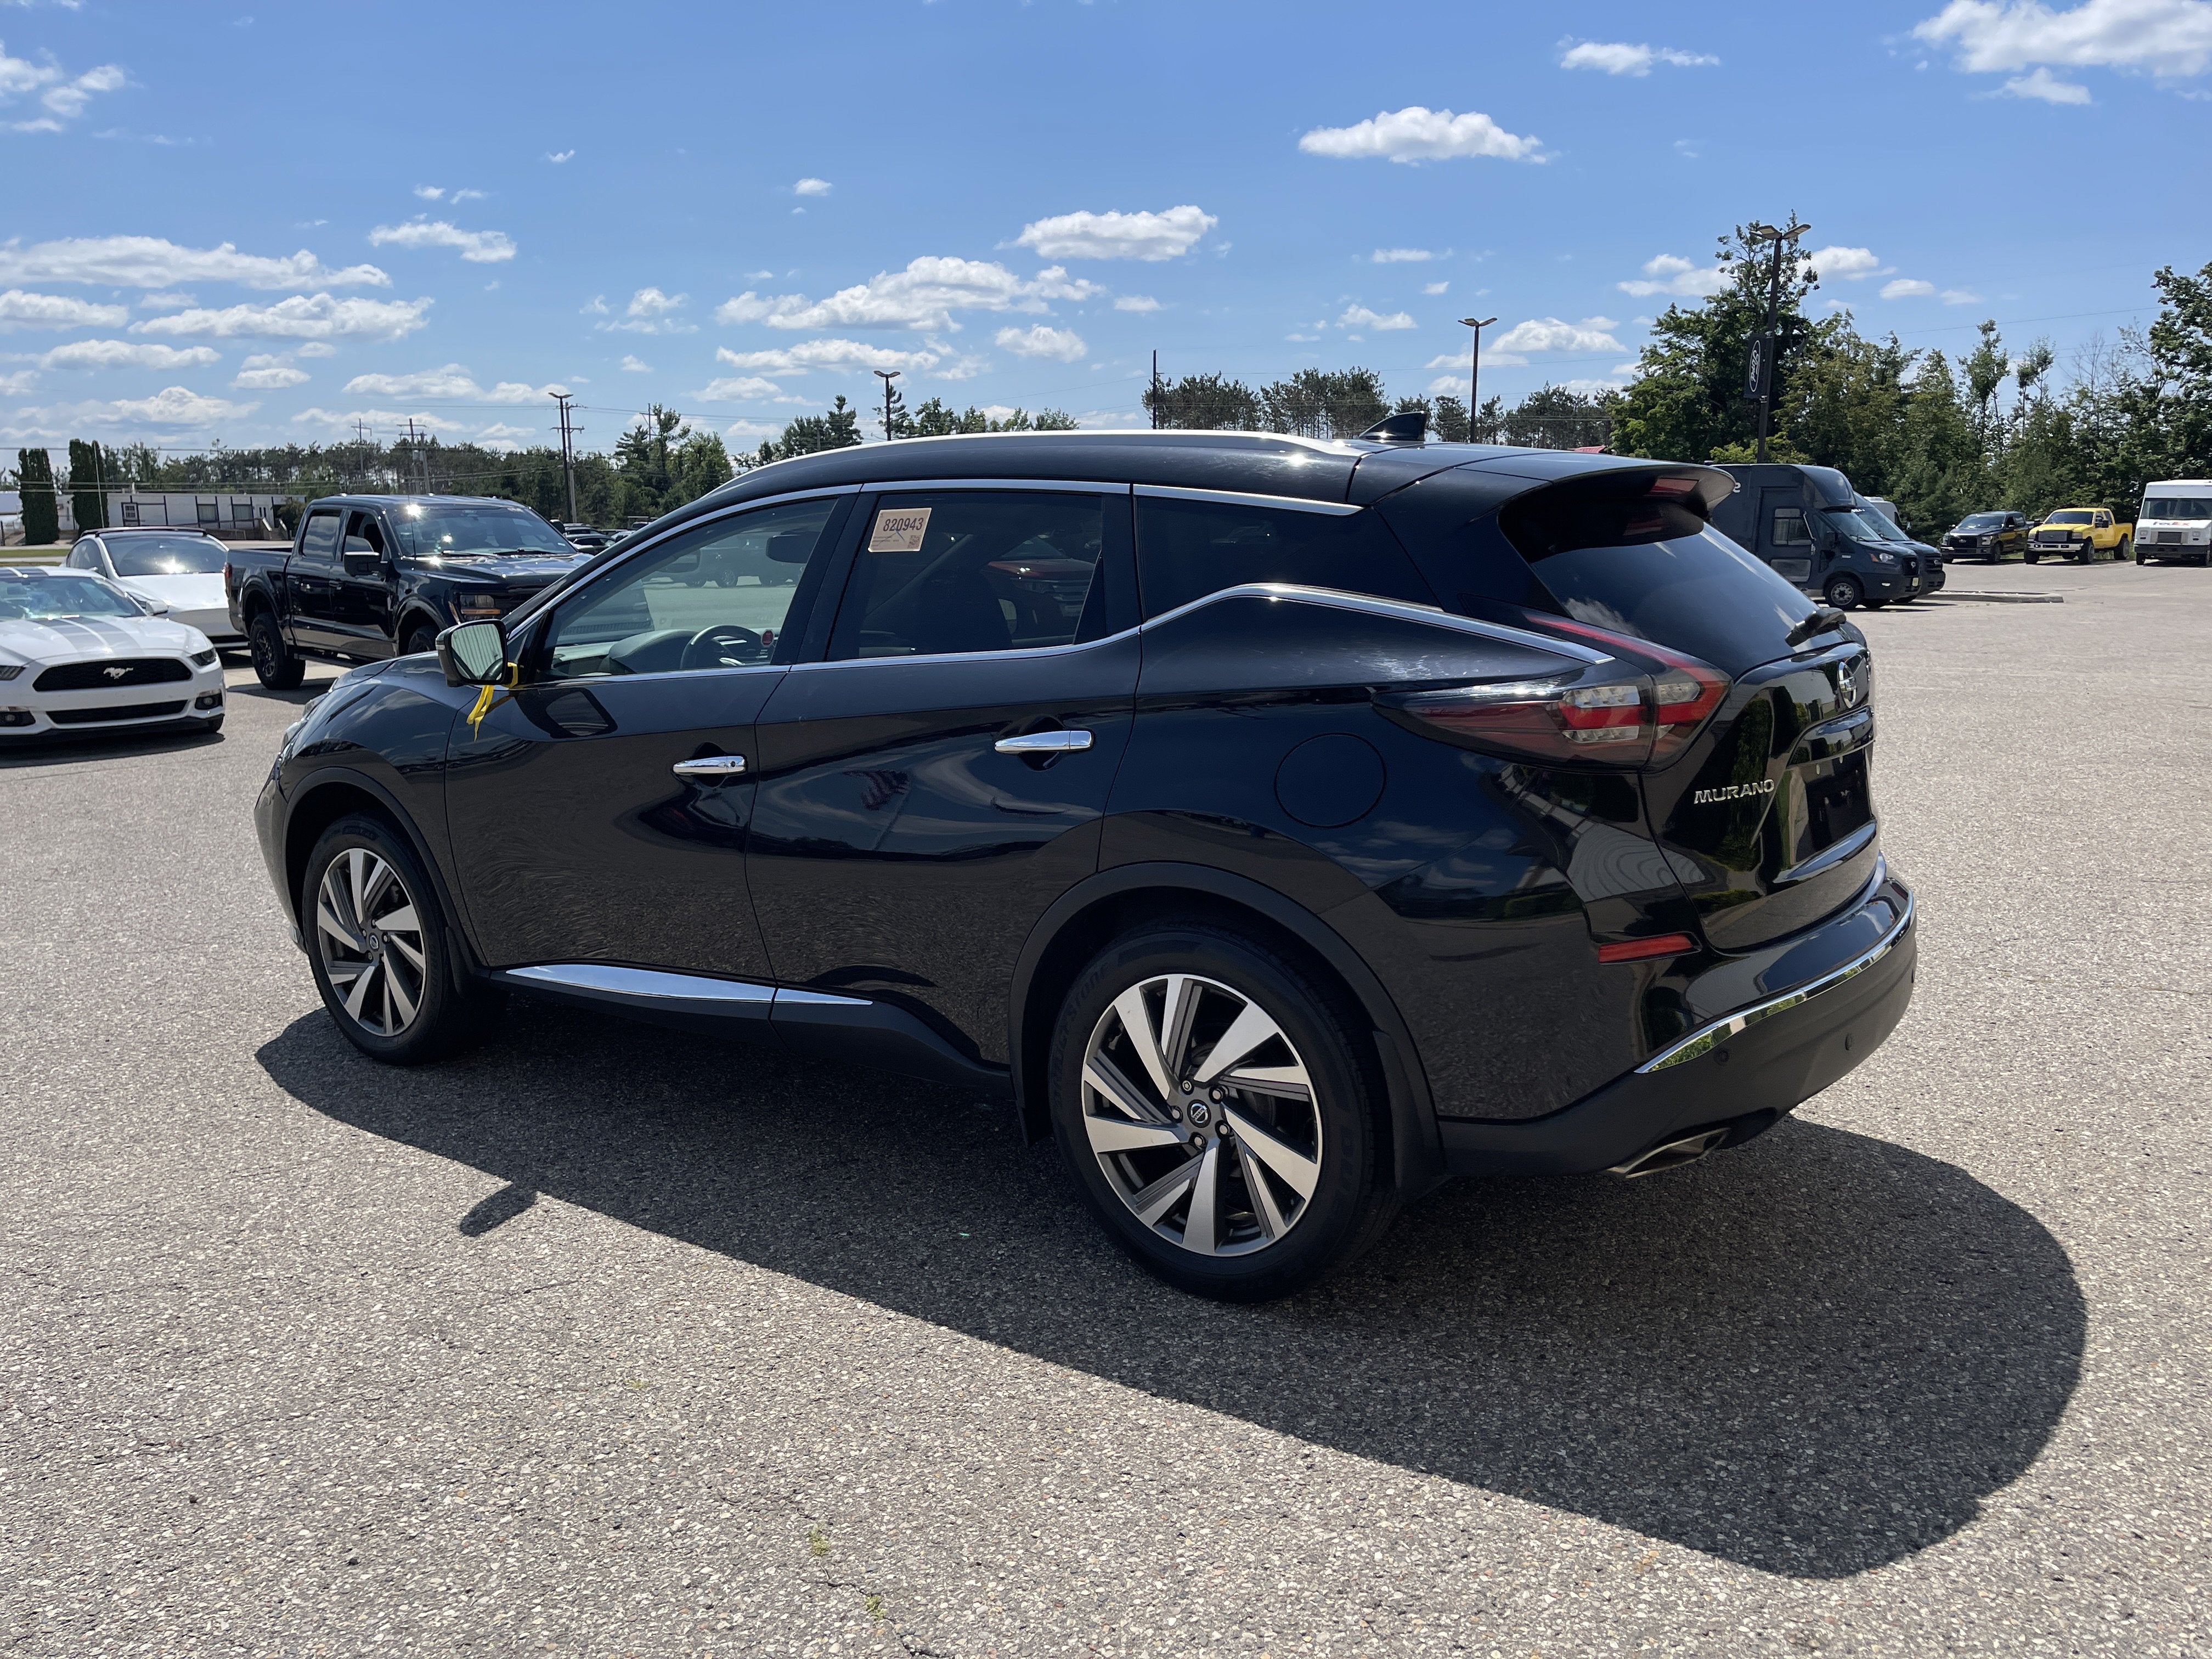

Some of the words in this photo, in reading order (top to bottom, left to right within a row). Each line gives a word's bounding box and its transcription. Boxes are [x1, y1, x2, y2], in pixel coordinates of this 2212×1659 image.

[1751, 349, 1759, 382] Ford
[883, 517, 924, 532] 820943
[1694, 779, 1774, 804] MURANO
